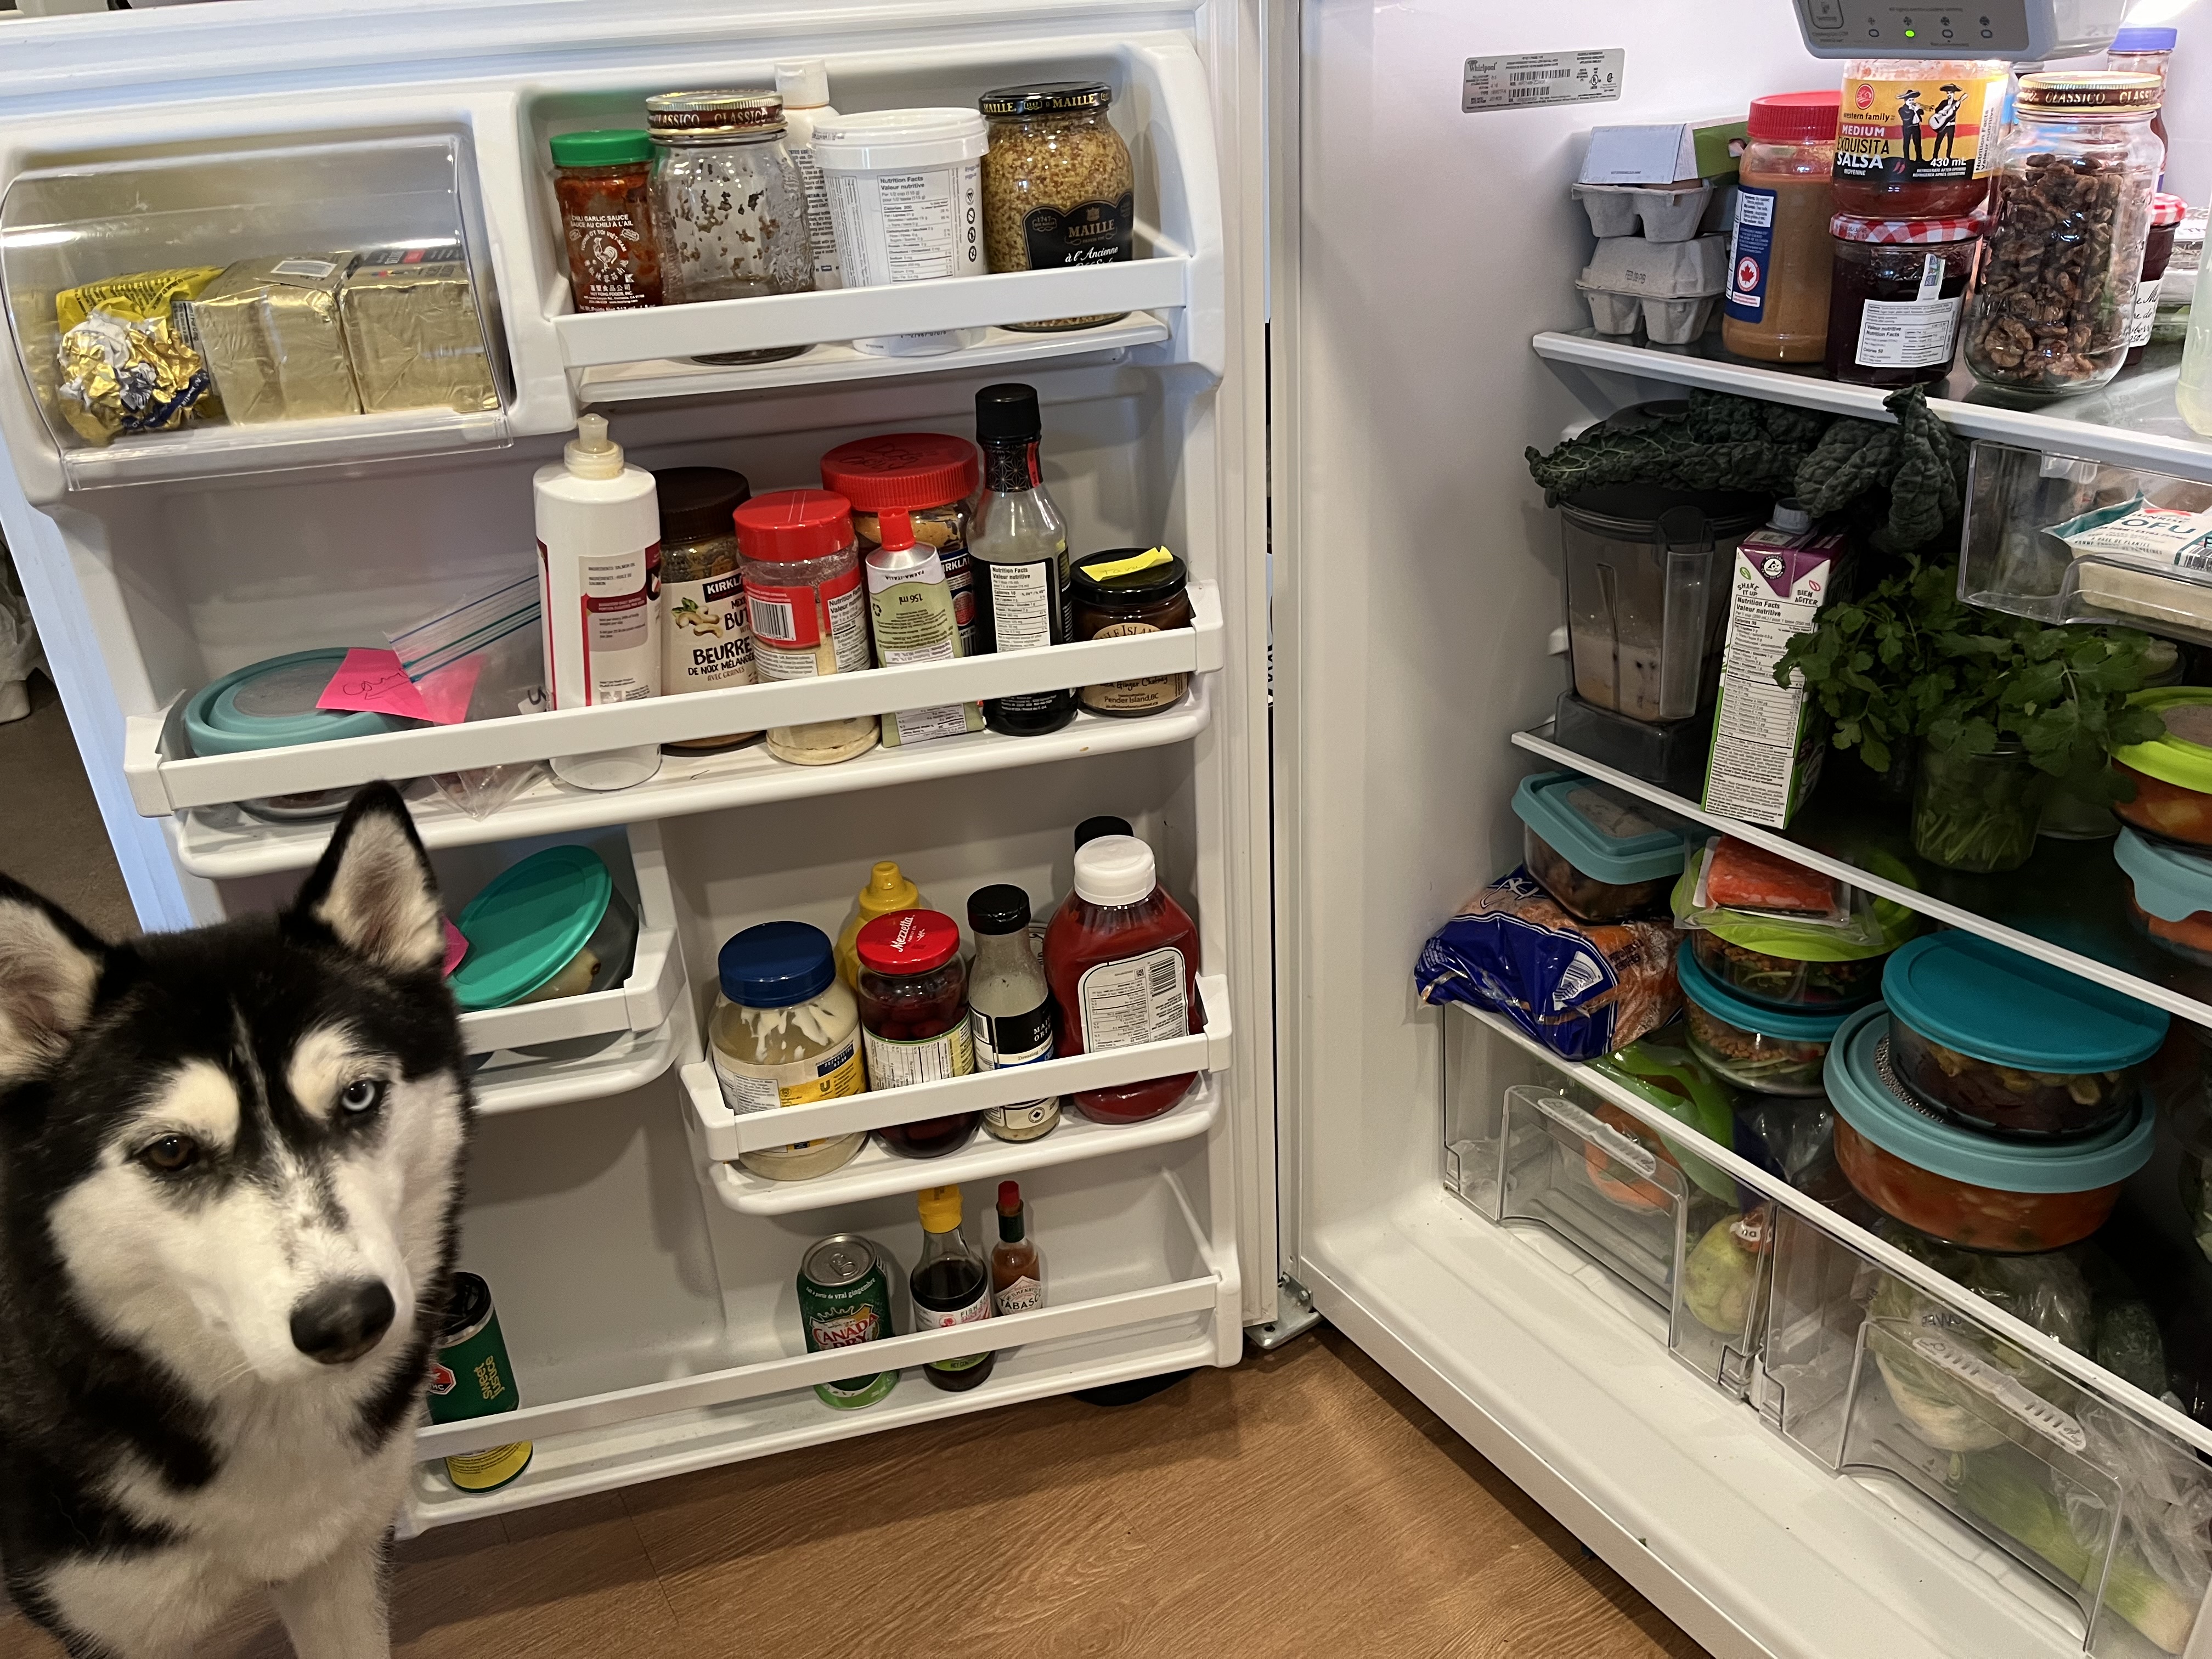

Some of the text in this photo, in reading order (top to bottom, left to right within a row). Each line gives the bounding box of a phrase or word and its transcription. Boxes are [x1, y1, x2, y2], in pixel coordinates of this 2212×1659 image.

[1469, 63, 1496, 73] Whirlpool
[1053, 94, 1096, 108] MAILLE
[2045, 91, 2105, 104] CLASSICO
[1865, 112, 1890, 123] family
[1842, 125, 1885, 137] MEDIUM
[1837, 137, 1889, 155] EXQUISITA
[1976, 135, 1985, 170] Nutrition
[1837, 151, 1883, 170] SALSA
[1930, 157, 1967, 167] 430 mL
[1844, 168, 1866, 176] MOYENNE
[1068, 219, 1115, 238] MAILLE
[1065, 253, 1073, 263] à
[2118, 518, 2197, 534] OFU
[1737, 583, 1759, 591] SHAKE
[1797, 589, 1814, 598] BIEN
[829, 594, 852, 607] Nutrition
[899, 593, 923, 605] 156 ml
[1737, 597, 1763, 607] Nutrition
[1795, 596, 1819, 606] AGITER
[830, 603, 848, 613] Valeur
[1736, 603, 1781, 617] Valeur nutritive
[692, 636, 753, 665] BEURRE
[688, 667, 699, 676] DE
[701, 663, 719, 675] NOIX
[707, 666, 745, 681] AVEC GRAINES
[1104, 696, 1128, 704] Pender
[890, 917, 914, 952] Mezzetta
[1018, 1051, 1039, 1061] Dressing
[848, 1277, 876, 1298] gingembre
[960, 1304, 978, 1317] FISH
[813, 1313, 879, 1345] CANADA
[833, 1330, 867, 1348] DRY
[473, 1362, 493, 1400] sweet
[486, 1355, 505, 1400] justice
